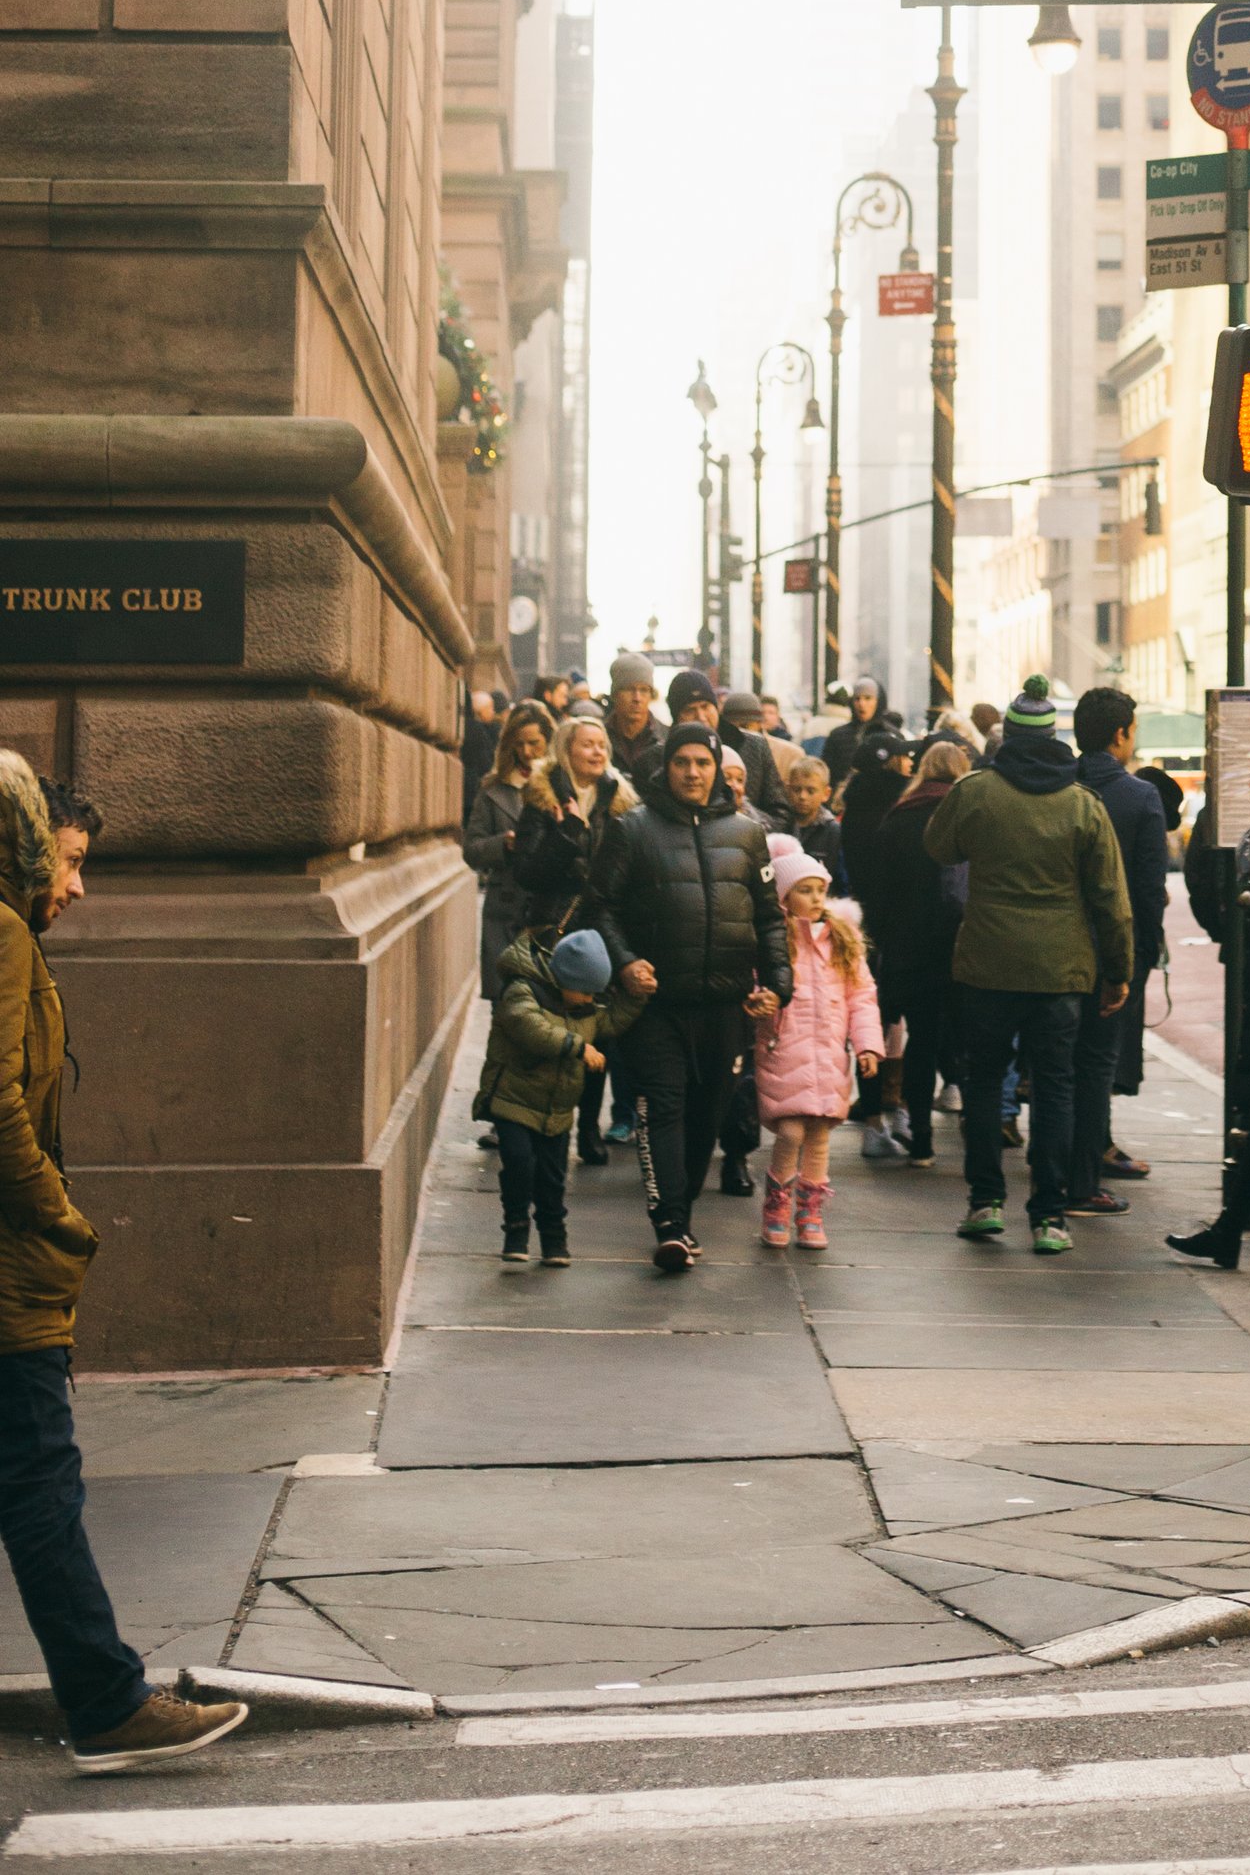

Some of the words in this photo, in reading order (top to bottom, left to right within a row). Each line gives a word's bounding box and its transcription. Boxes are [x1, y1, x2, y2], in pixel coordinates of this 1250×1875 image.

[1198, 97, 1215, 118] NO
[1150, 164, 1178, 179] Co-op
[1180, 161, 1199, 176] City
[1150, 204, 1164, 217] Pick
[1180, 201, 1196, 215] Drop
[1150, 246, 1191, 260] Madison
[1196, 244, 1208, 257] Av
[1214, 242, 1222, 255] &
[1150, 262, 1171, 276] East
[1176, 260, 1187, 274] 51
[1190, 258, 1202, 273] St
[2, 587, 112, 612] TRUNK
[121, 587, 203, 612] CLUB
